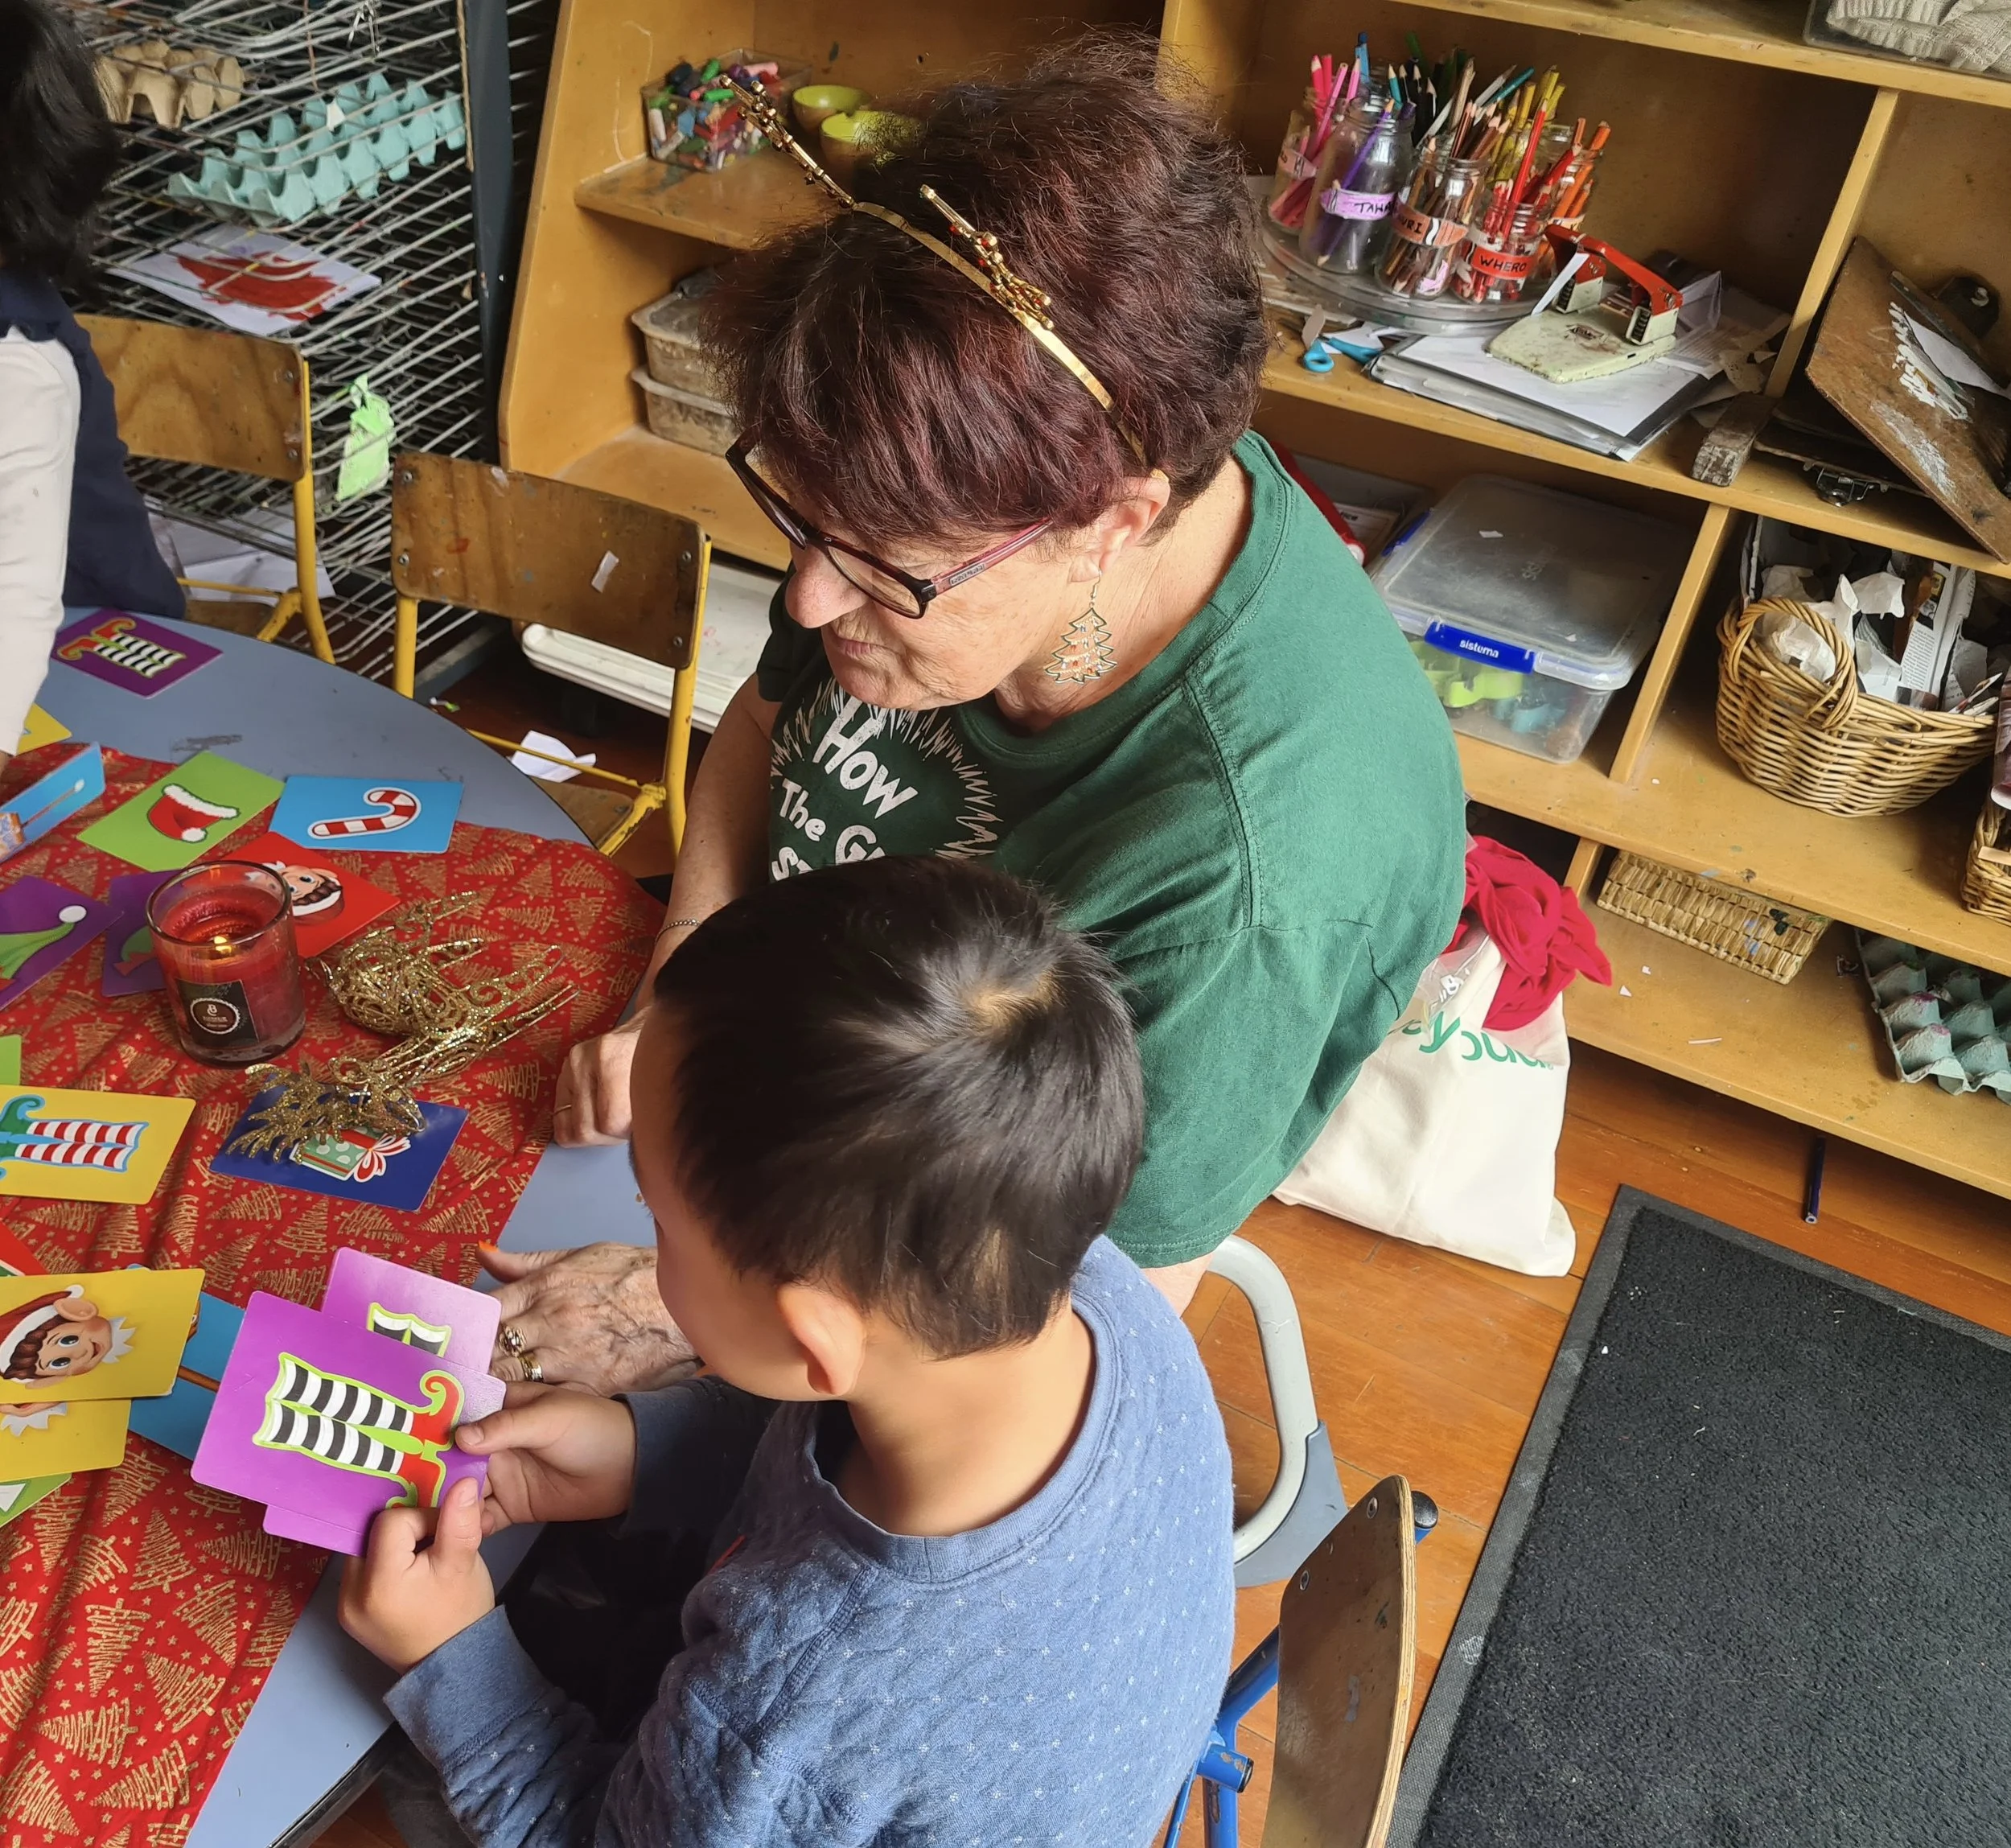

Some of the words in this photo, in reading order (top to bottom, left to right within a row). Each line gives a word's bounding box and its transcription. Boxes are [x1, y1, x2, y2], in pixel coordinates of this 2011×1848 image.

[1480, 255, 1528, 273] WHERO
[1459, 640, 1499, 658] sistema
[812, 696, 919, 819] How
[779, 778, 826, 842] The
